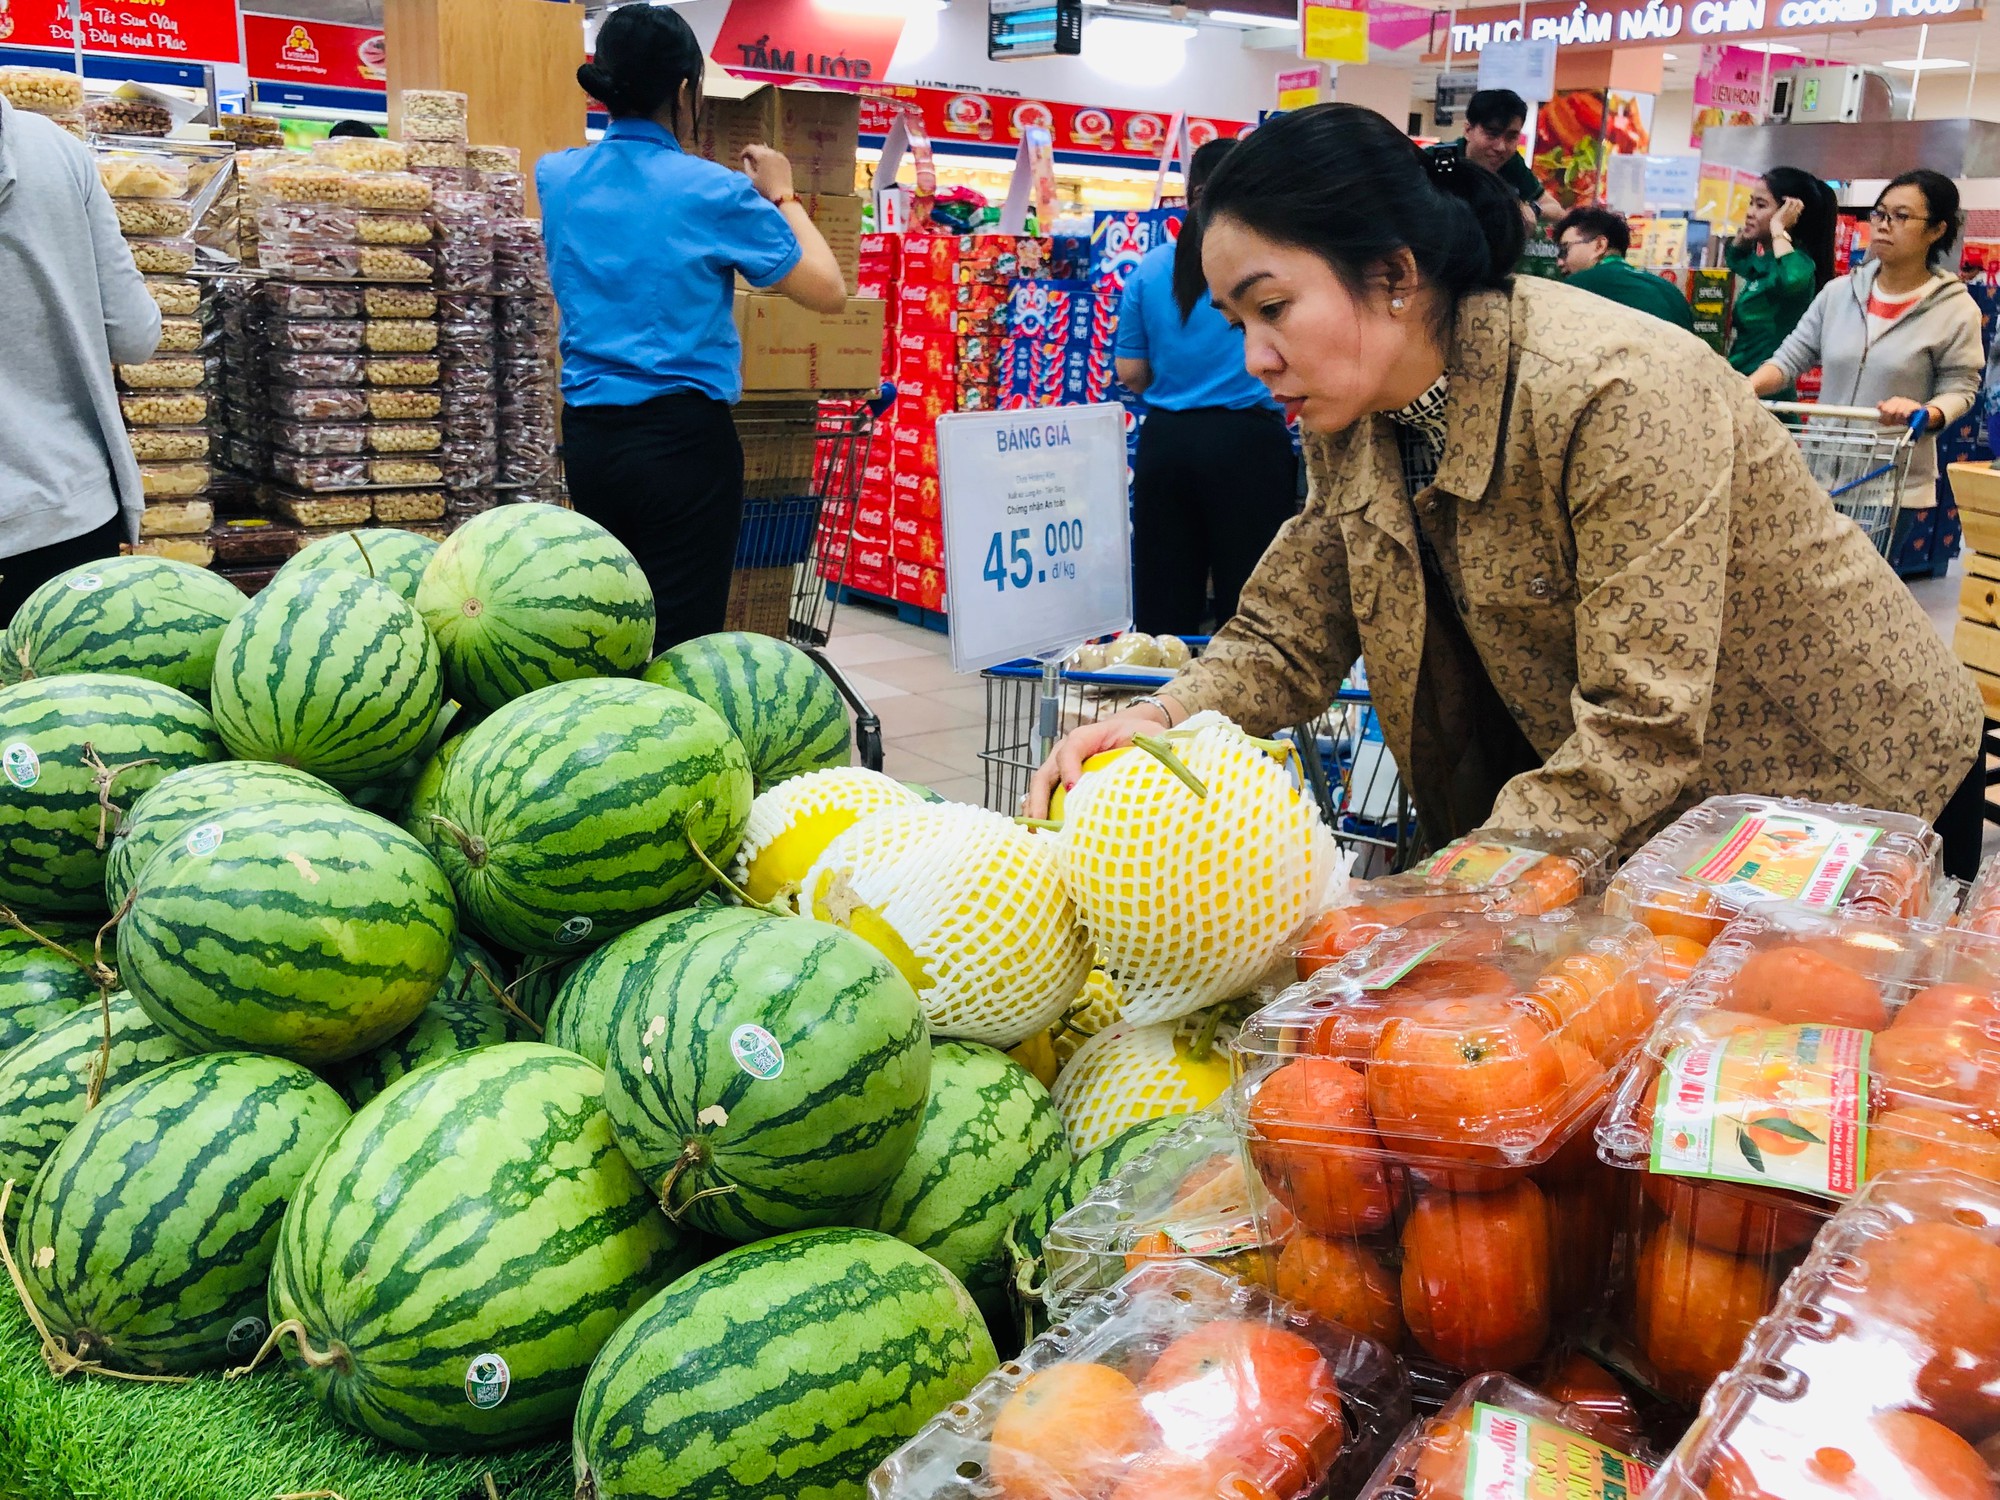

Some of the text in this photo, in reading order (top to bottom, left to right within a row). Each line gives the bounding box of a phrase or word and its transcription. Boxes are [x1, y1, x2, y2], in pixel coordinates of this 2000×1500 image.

[120, 12, 148, 28] Sum
[1045, 420, 1071, 447] GIÁ
[1833, 1139, 1843, 1154] TP
